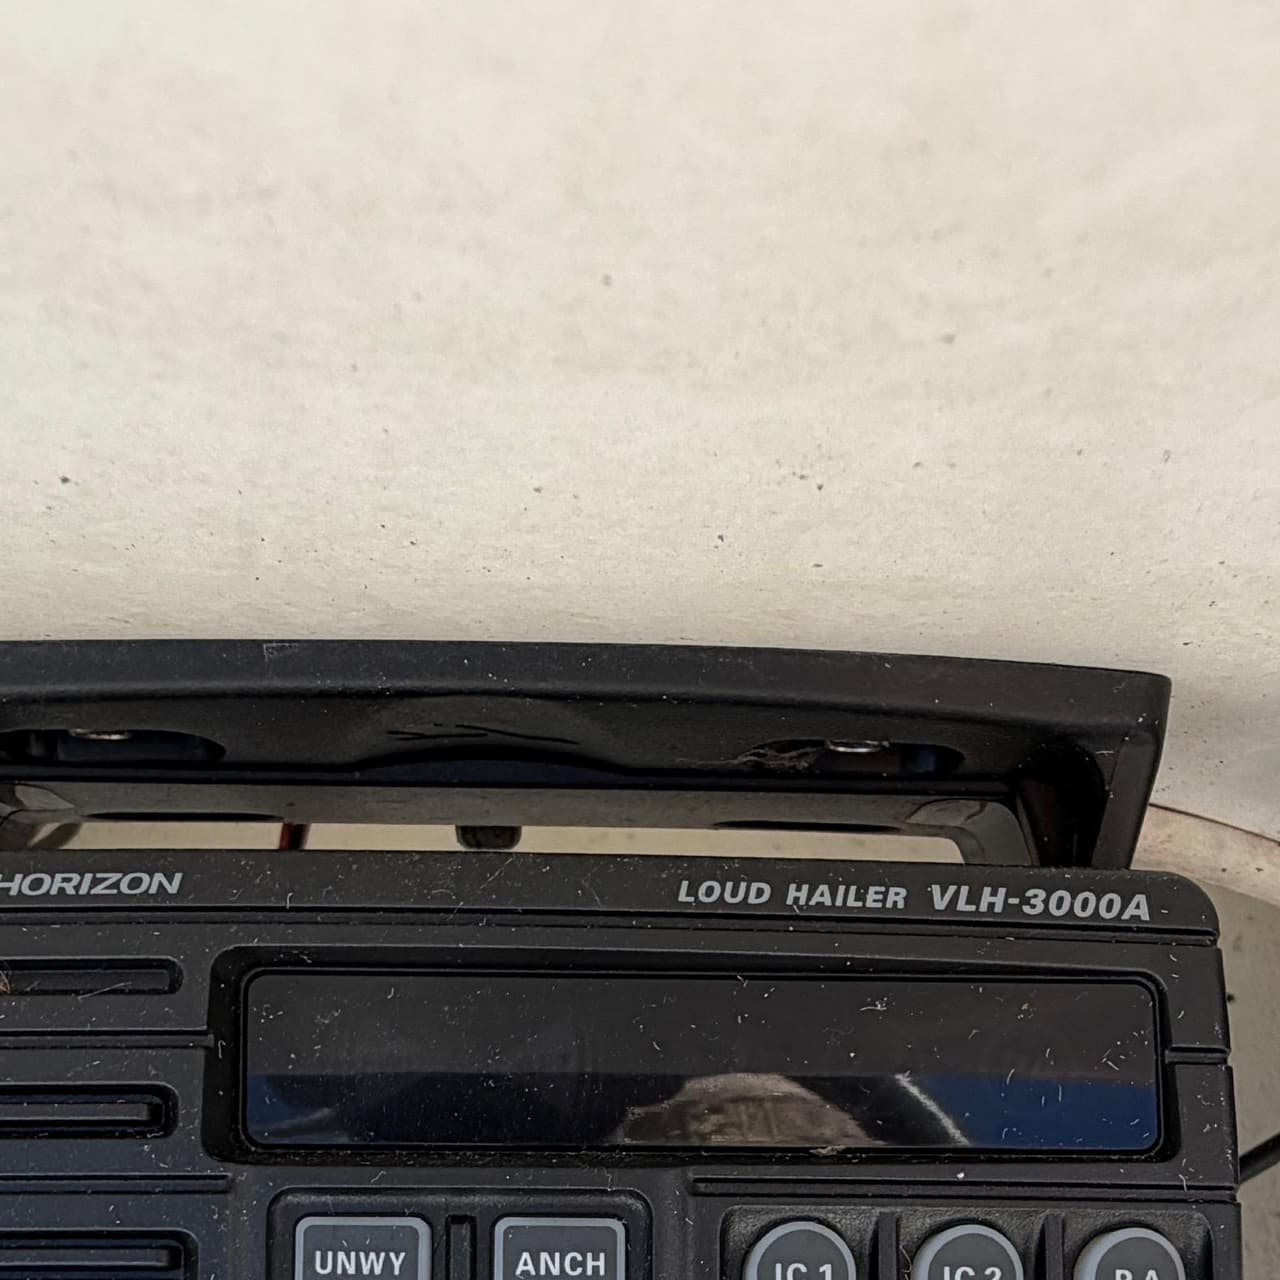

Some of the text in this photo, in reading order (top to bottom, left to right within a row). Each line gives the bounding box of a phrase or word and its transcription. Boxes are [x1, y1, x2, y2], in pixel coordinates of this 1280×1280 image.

[677, 880, 1151, 922] LOUD HAILER VLH-3000A
[313, 1250, 406, 1277] UNWY
[514, 1251, 607, 1277] ANCH
